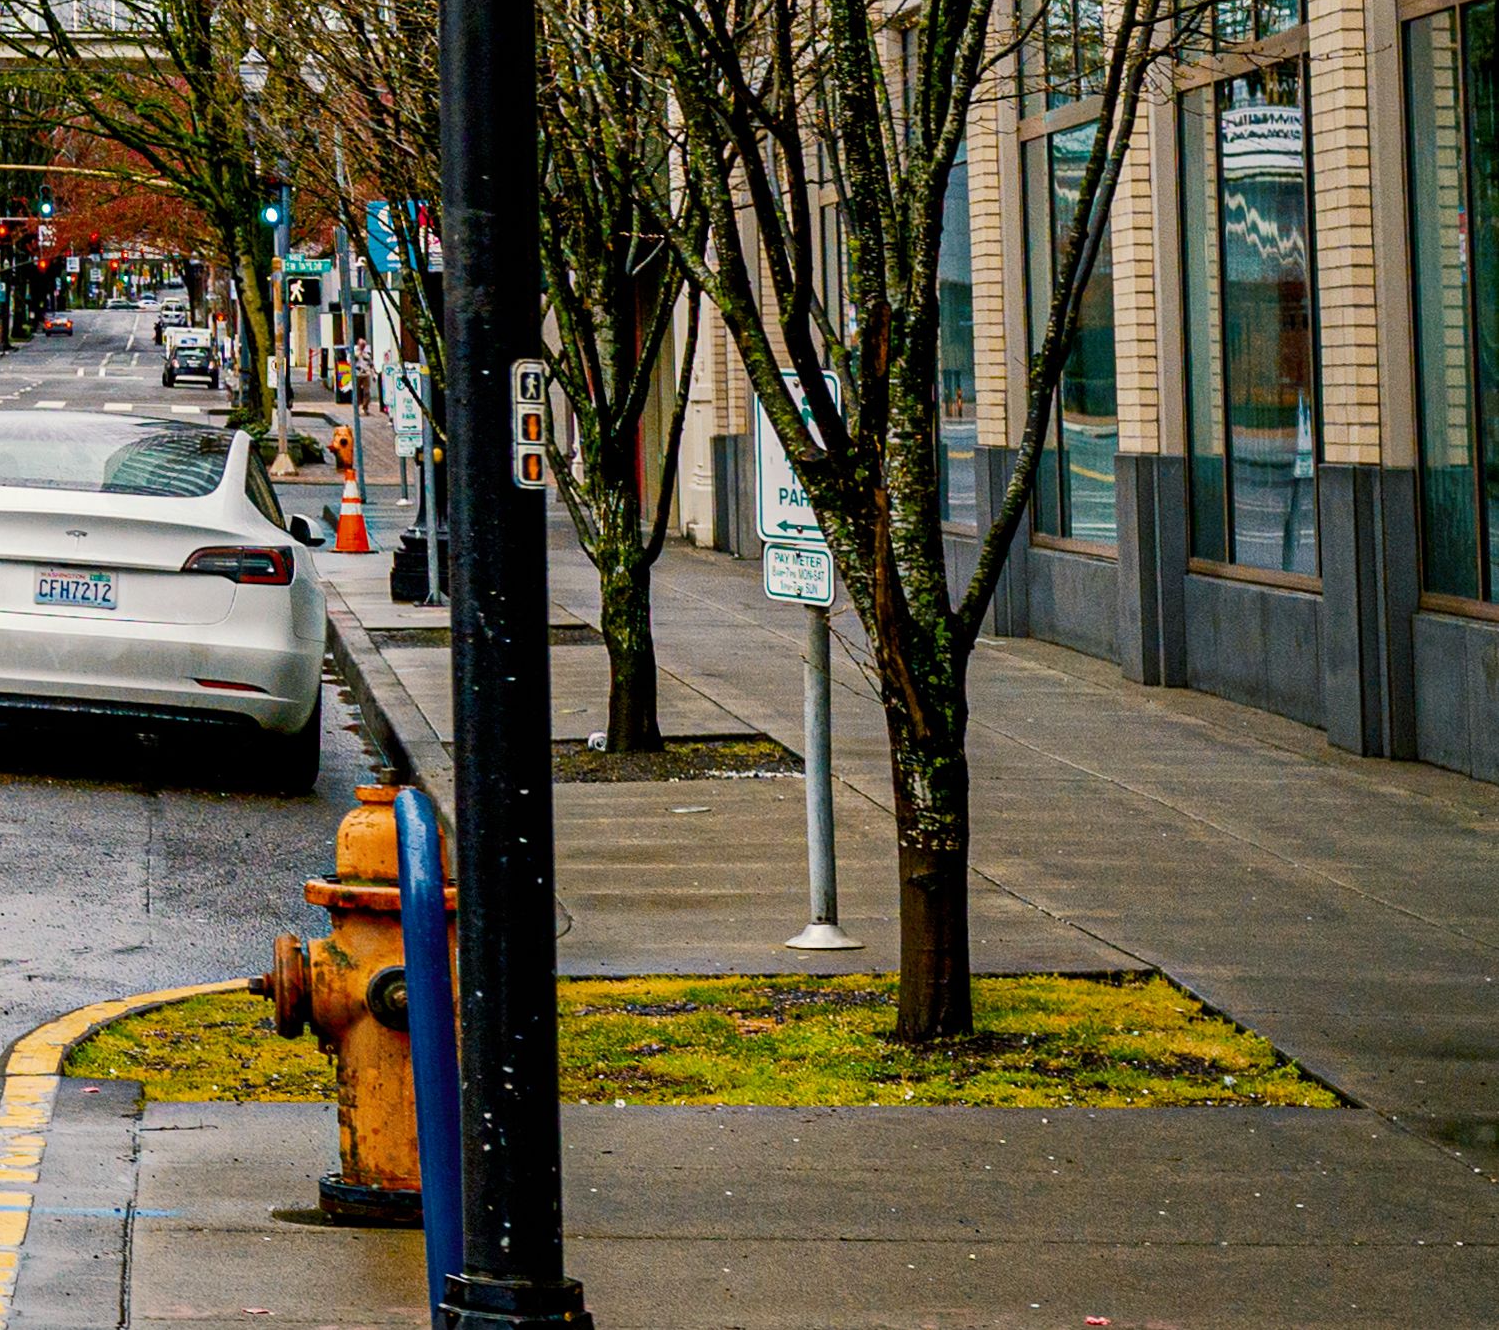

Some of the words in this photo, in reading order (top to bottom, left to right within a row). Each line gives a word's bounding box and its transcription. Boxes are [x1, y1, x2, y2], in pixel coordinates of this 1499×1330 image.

[778, 487, 811, 508] PAR
[774, 552, 790, 564] PAY
[793, 554, 823, 568] METER
[39, 579, 111, 603] CFH7212
